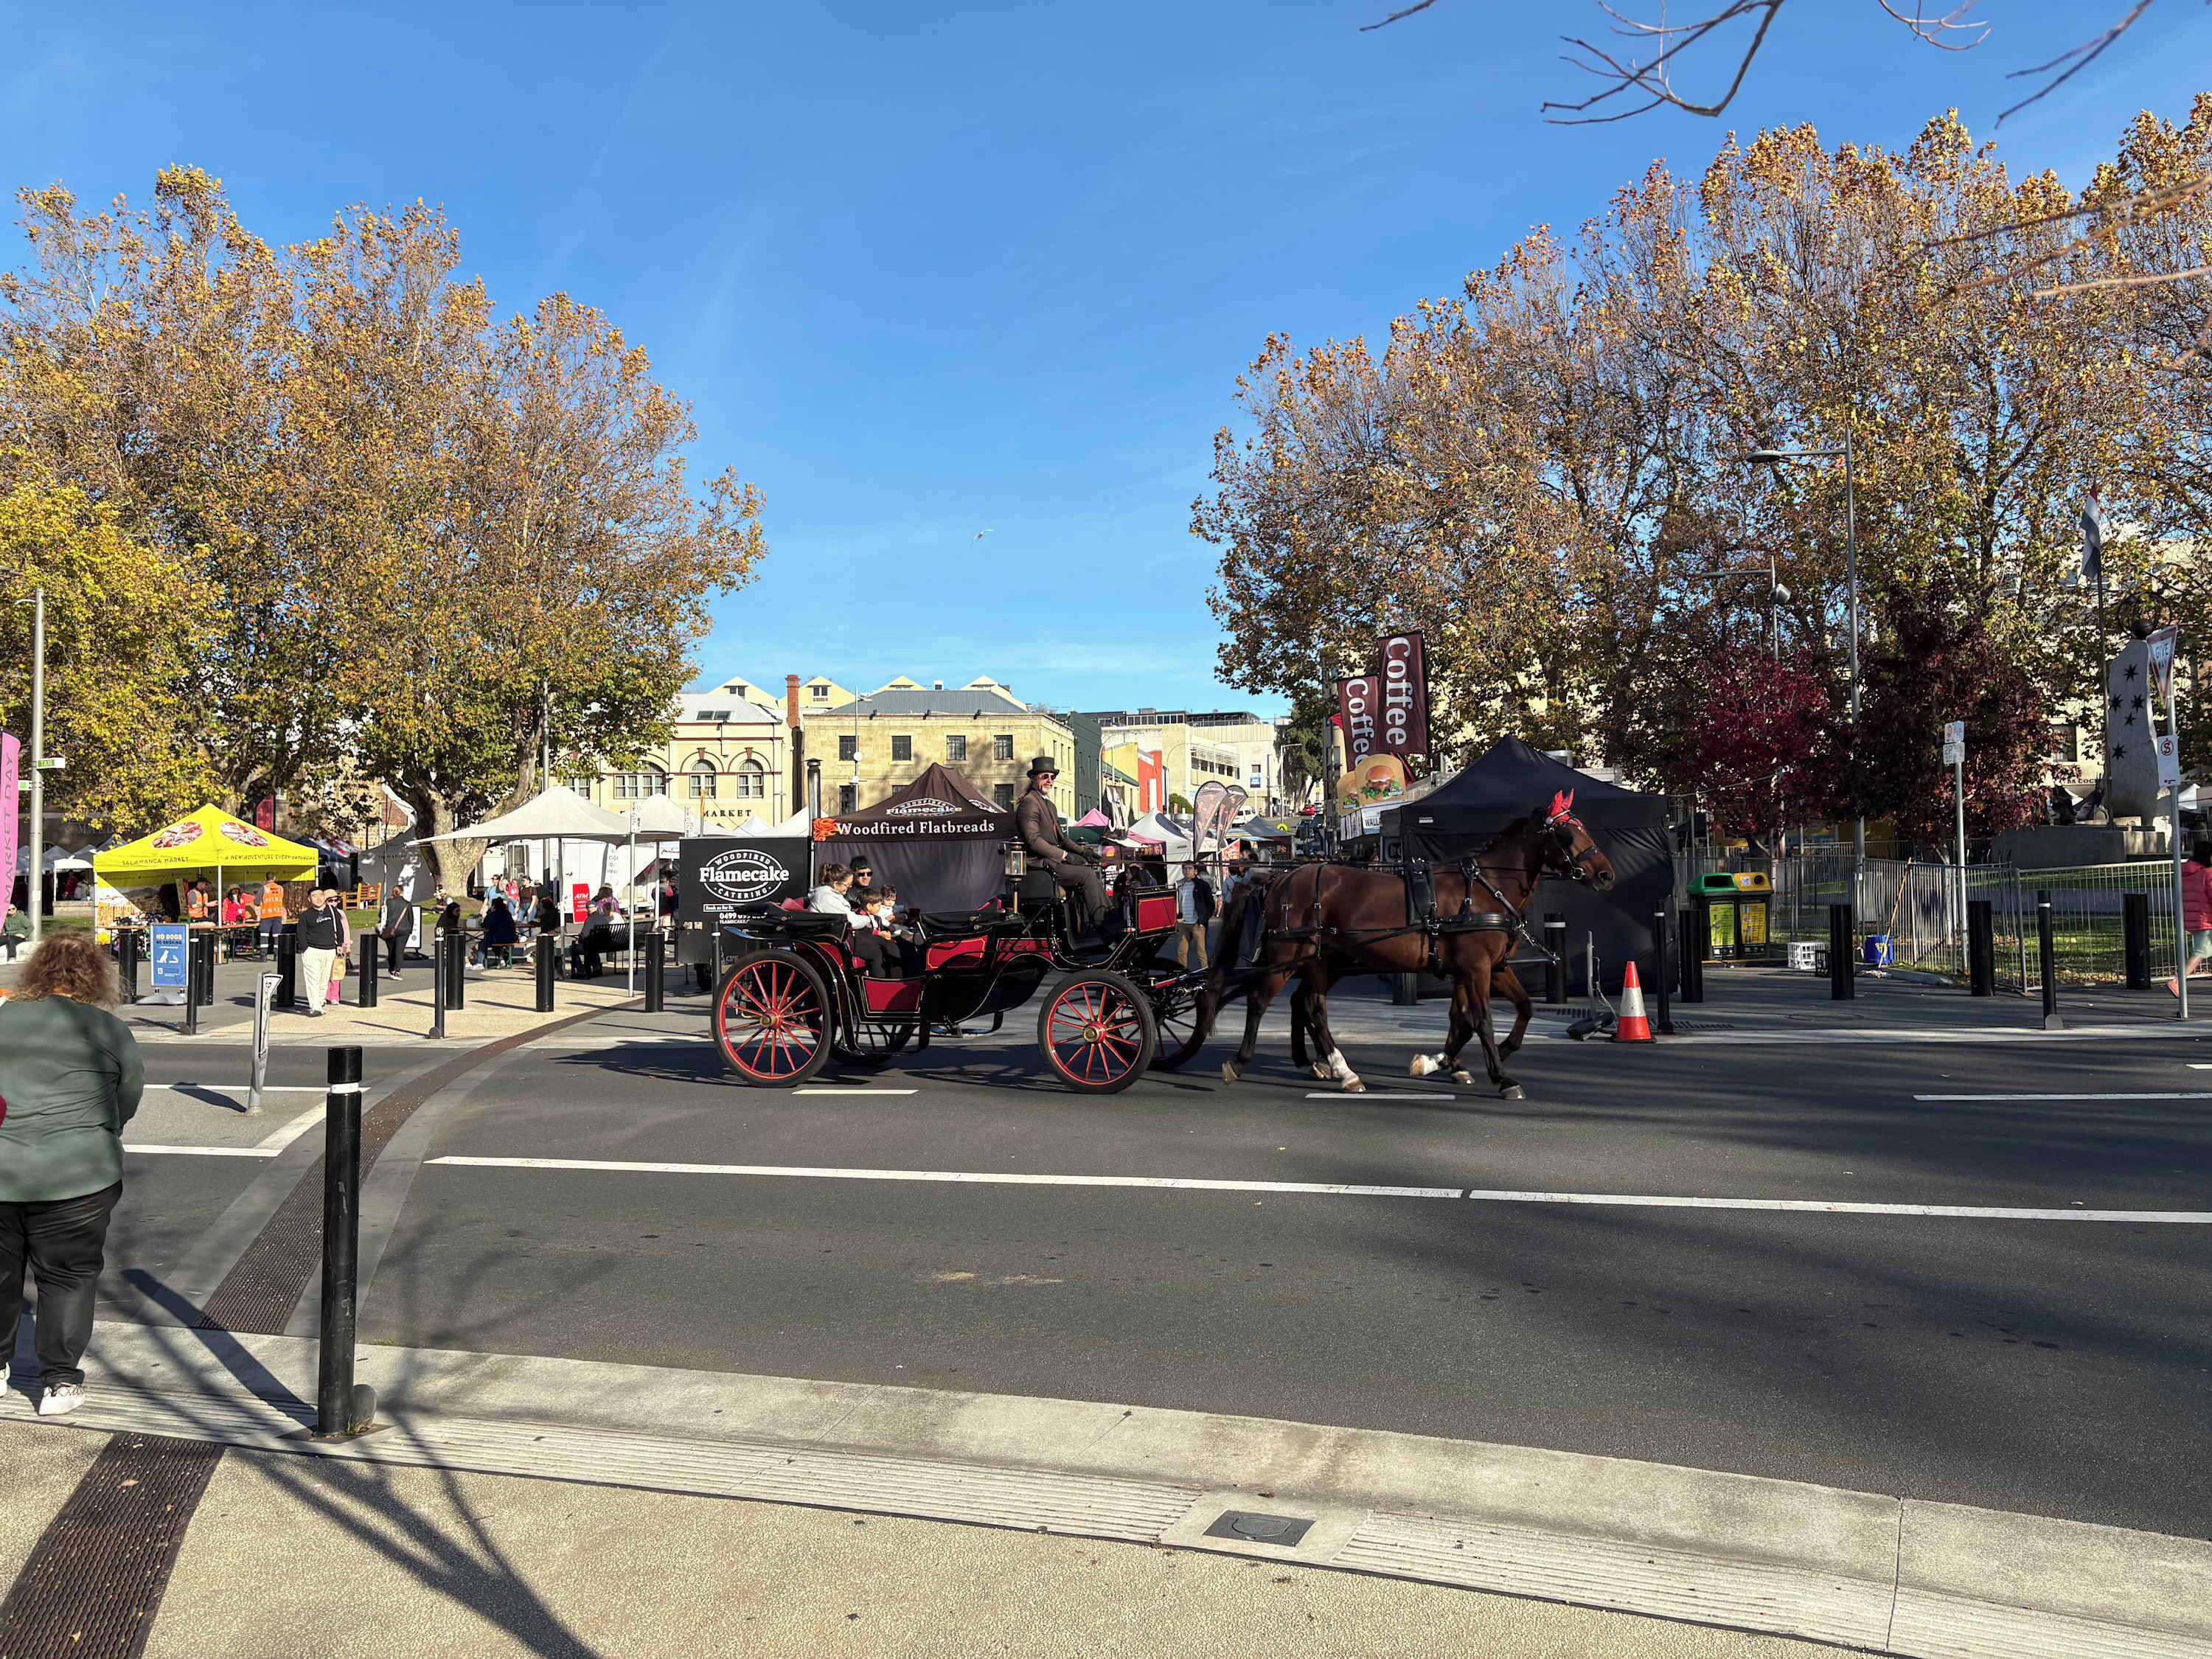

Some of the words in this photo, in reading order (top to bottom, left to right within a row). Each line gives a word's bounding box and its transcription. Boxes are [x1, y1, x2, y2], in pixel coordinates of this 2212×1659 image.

[2156, 643, 2168, 658] GIVE
[1386, 637, 1413, 745] Coffee
[4, 752, 13, 801] DAY
[703, 810, 752, 818] MARKET
[886, 806, 963, 815] Flamecake
[836, 821, 914, 835] Woodfired
[919, 819, 995, 834] Flatbreads
[4, 807, 13, 905] MARKET
[122, 858, 161, 866] SALAMANCA
[714, 852, 771, 866] WOODFIRED
[699, 866, 790, 883] Flamecake
[717, 887, 768, 899] CATERING
